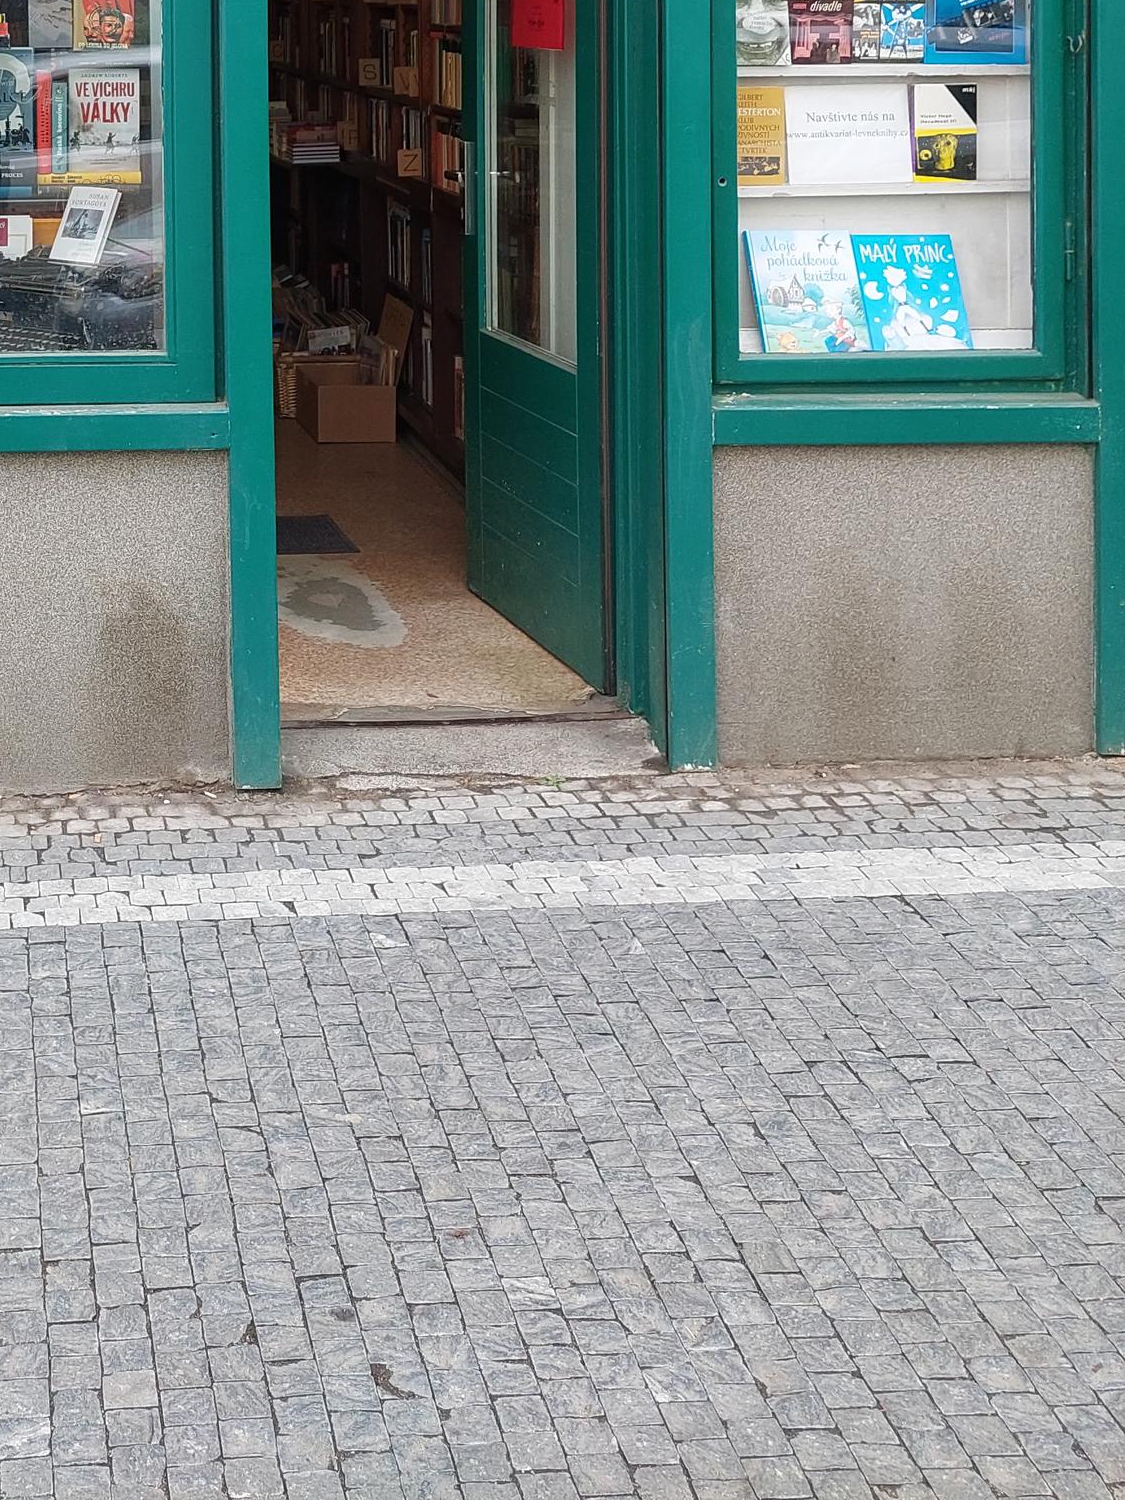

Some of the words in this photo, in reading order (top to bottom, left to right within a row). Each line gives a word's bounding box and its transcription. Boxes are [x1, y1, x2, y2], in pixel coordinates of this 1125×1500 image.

[809, 0, 843, 12] divadle
[75, 82, 90, 98] VE
[80, 97, 131, 124] VÁLKY
[805, 110, 858, 124] Navštivte
[860, 110, 879, 123] nás
[882, 113, 895, 122] na
[402, 153, 420, 172] Z
[760, 235, 797, 252] Moje
[859, 237, 897, 264] MALÝ
[902, 243, 951, 264] PRINC
[766, 251, 839, 270] pohádková
[803, 266, 848, 282] knížka
